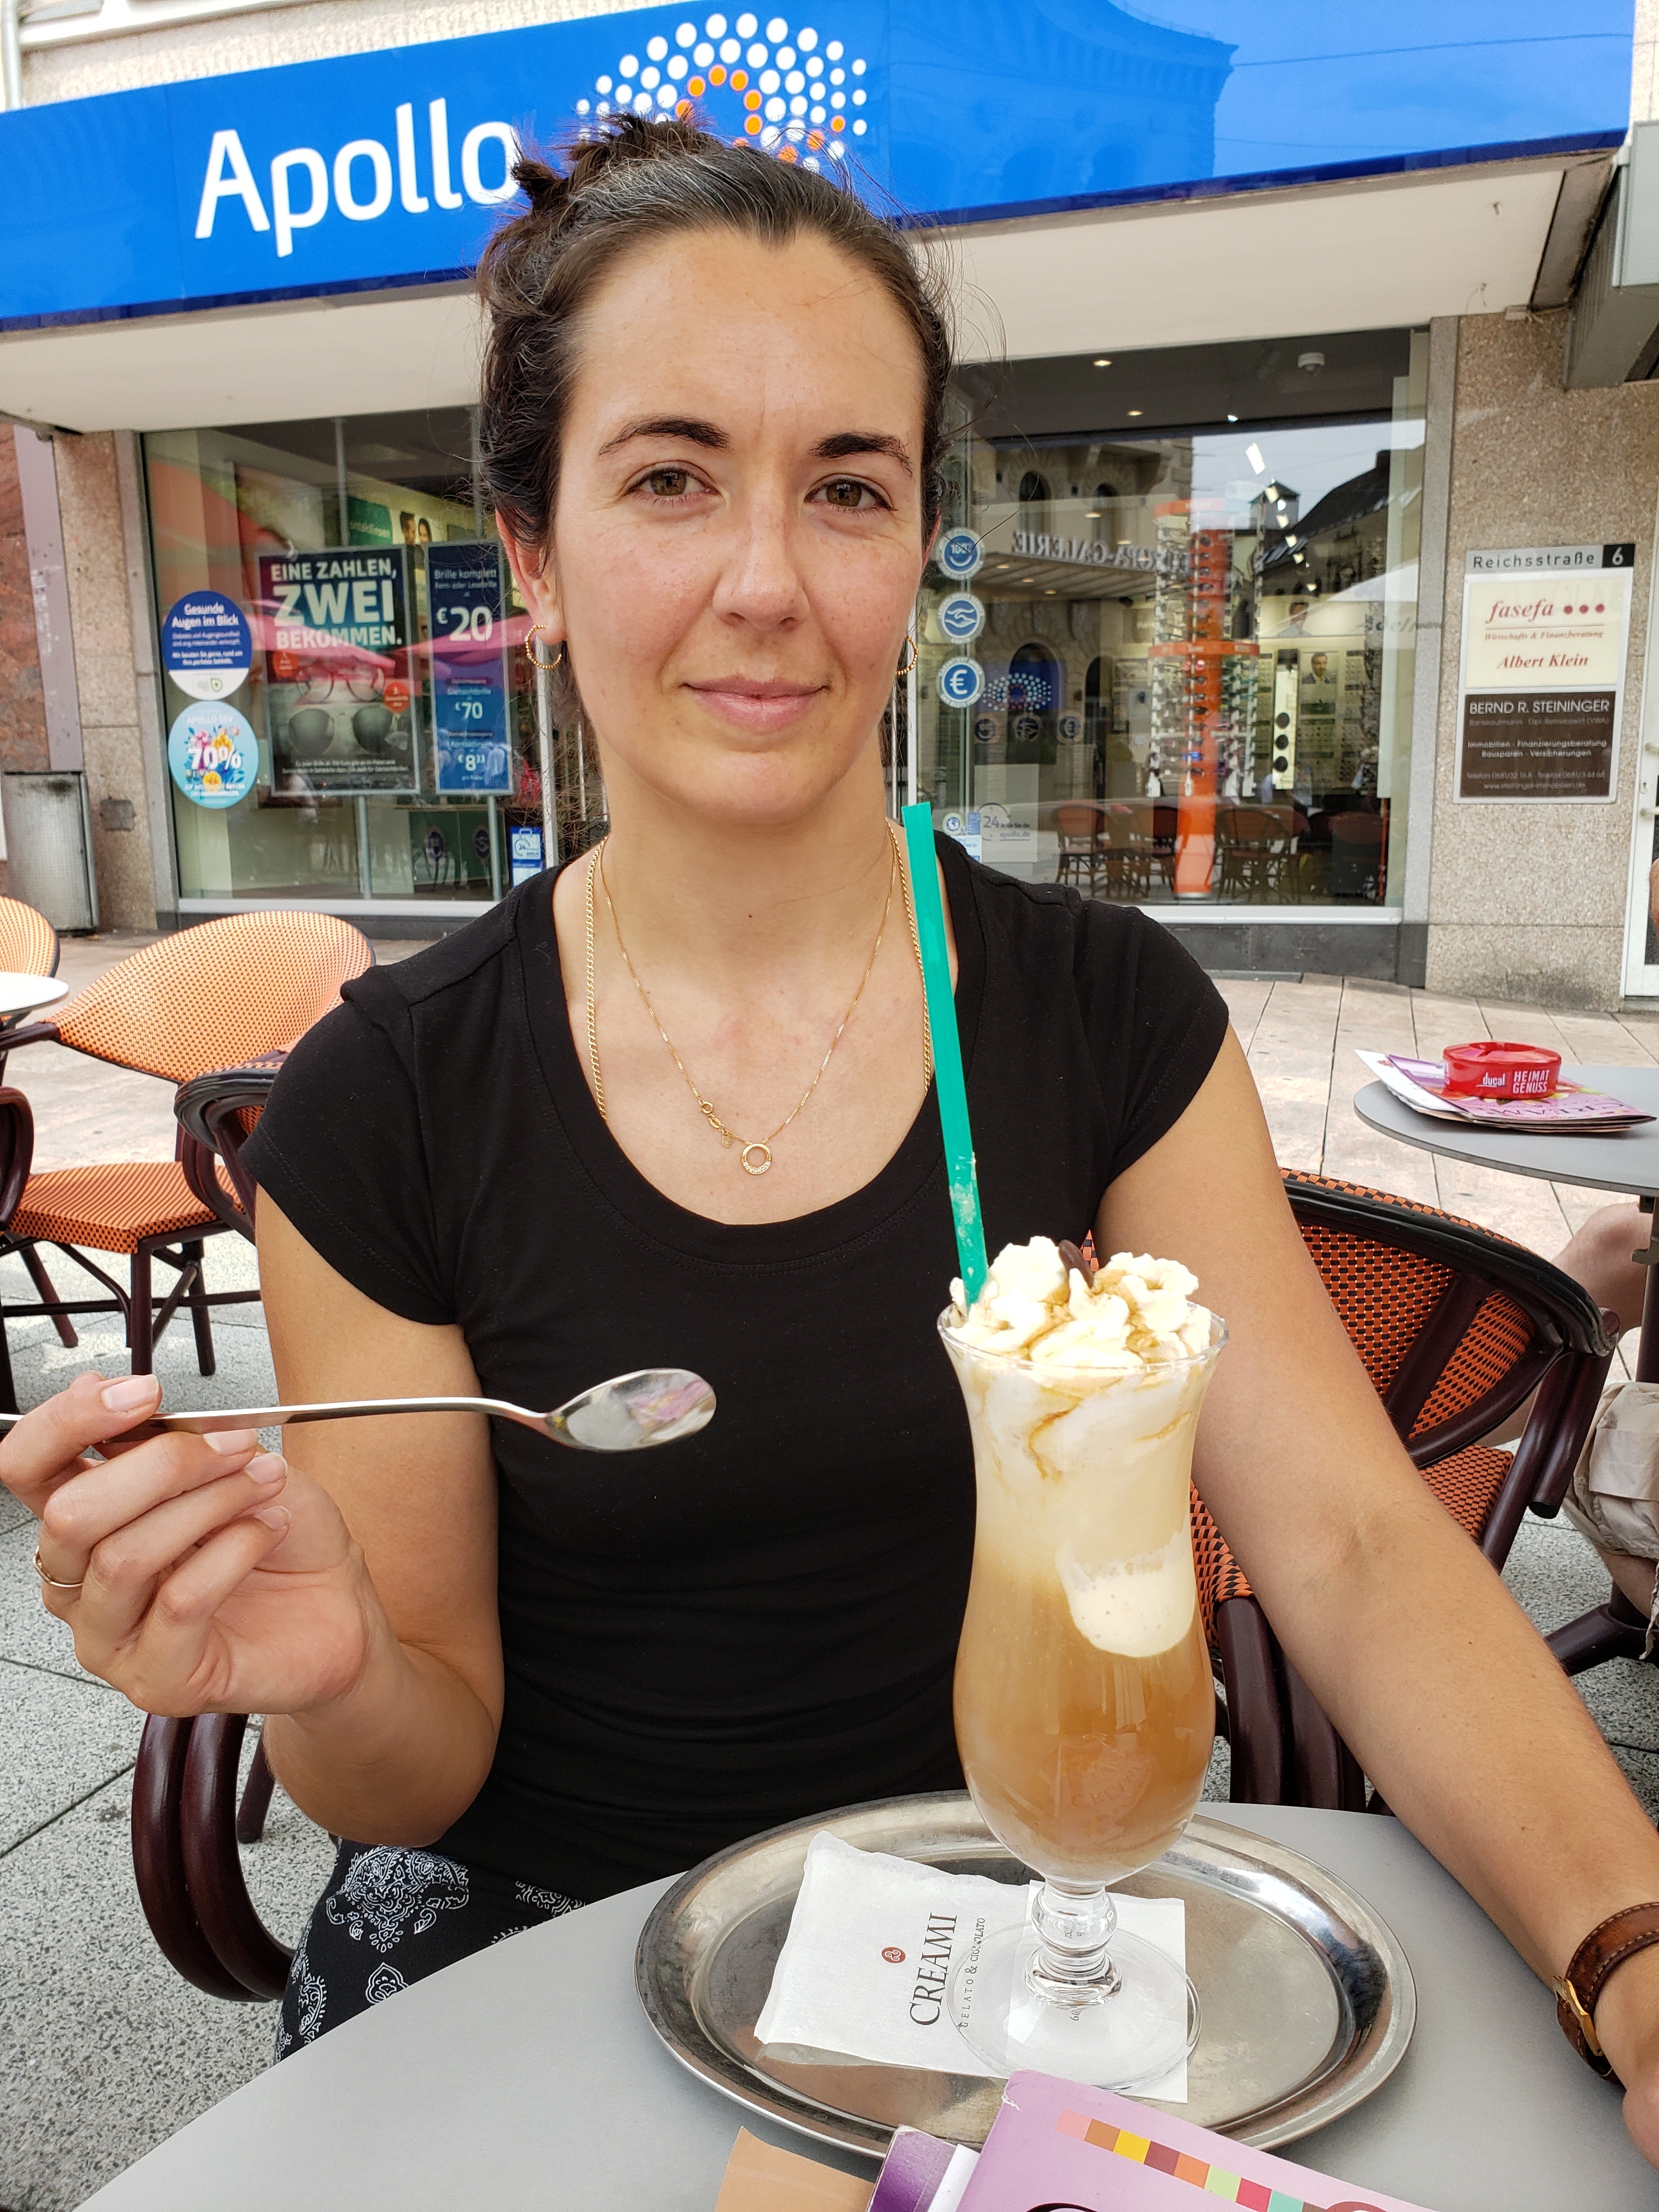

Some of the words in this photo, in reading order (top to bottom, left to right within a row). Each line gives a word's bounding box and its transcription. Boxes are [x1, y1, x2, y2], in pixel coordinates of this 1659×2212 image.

[195, 97, 521, 258] Apollo
[1473, 551, 1595, 568] Reichsstraße
[1612, 546, 1624, 566] 6
[270, 562, 312, 582] EINE
[315, 557, 397, 579] ZAHLEN,
[433, 569, 457, 579] Brille
[459, 568, 497, 579] komplett
[184, 602, 224, 616] Gesunde
[273, 579, 395, 627] ZWEI
[1486, 597, 1554, 624] fasefa
[172, 616, 201, 630] Augen
[202, 615, 216, 627] im
[216, 613, 239, 627] Blick
[276, 625, 403, 649] BEKOMMEN.
[1497, 655, 1544, 669] Albert
[1548, 653, 1589, 668] Klein
[1470, 701, 1514, 714] BERND
[1517, 701, 1529, 713] R.
[1532, 698, 1610, 713] STEININGER
[188, 744, 242, 771] 70%
[1481, 750, 1523, 759] Bausparen
[1530, 748, 1592, 759] Versicherungen
[983, 815, 1000, 828] 24
[1482, 1071, 1505, 1086] ducal
[1514, 1069, 1550, 1082] HEIMAT
[1513, 1081, 1548, 1094] GENUSS
[909, 1912, 957, 2026] CREAMI
[964, 1965, 978, 1974] &
[959, 1978, 974, 2029] GELATO
